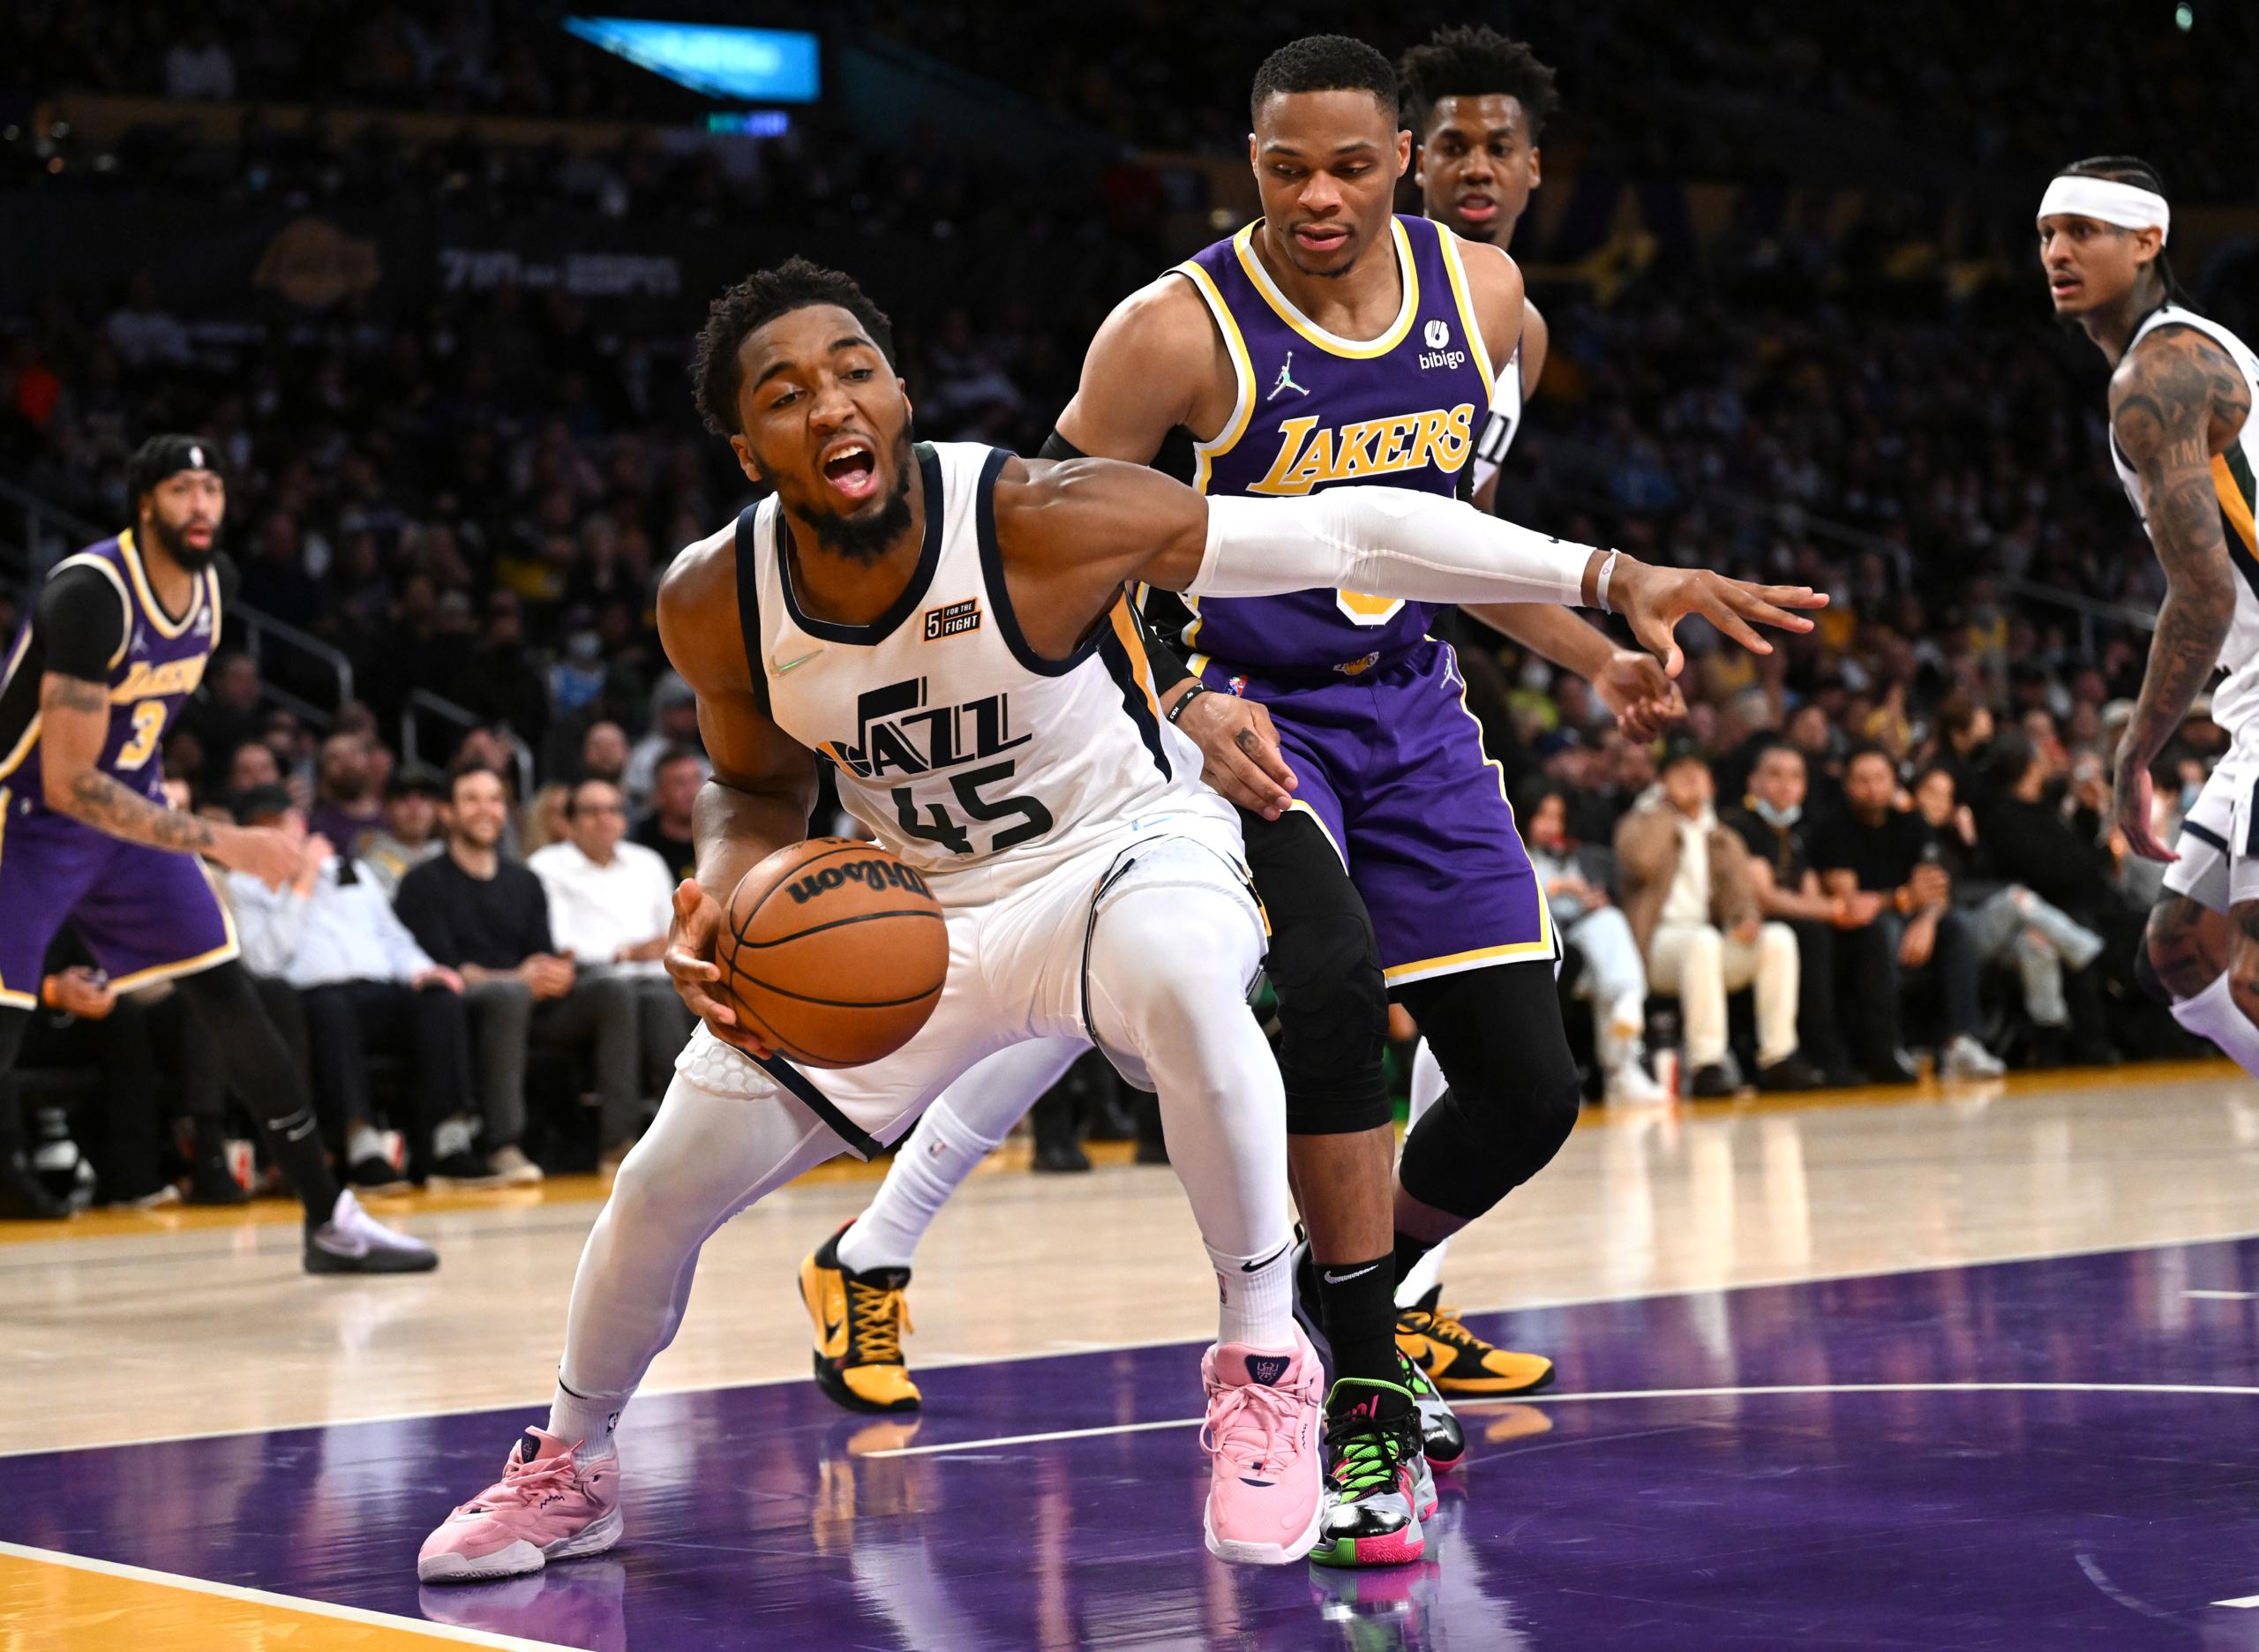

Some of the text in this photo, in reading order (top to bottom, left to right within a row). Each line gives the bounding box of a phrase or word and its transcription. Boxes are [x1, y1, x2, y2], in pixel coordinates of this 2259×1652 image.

[1418, 349, 1465, 370] bibigo
[1245, 403, 1475, 496] LAKERS
[927, 612, 940, 638] 5
[944, 614, 979, 635] FIGHT
[946, 603, 972, 617] FOR THE
[112, 698, 169, 771] 3
[815, 676, 1032, 777] JAZZ
[891, 759, 1054, 854] 45
[784, 859, 934, 905] Wilson
